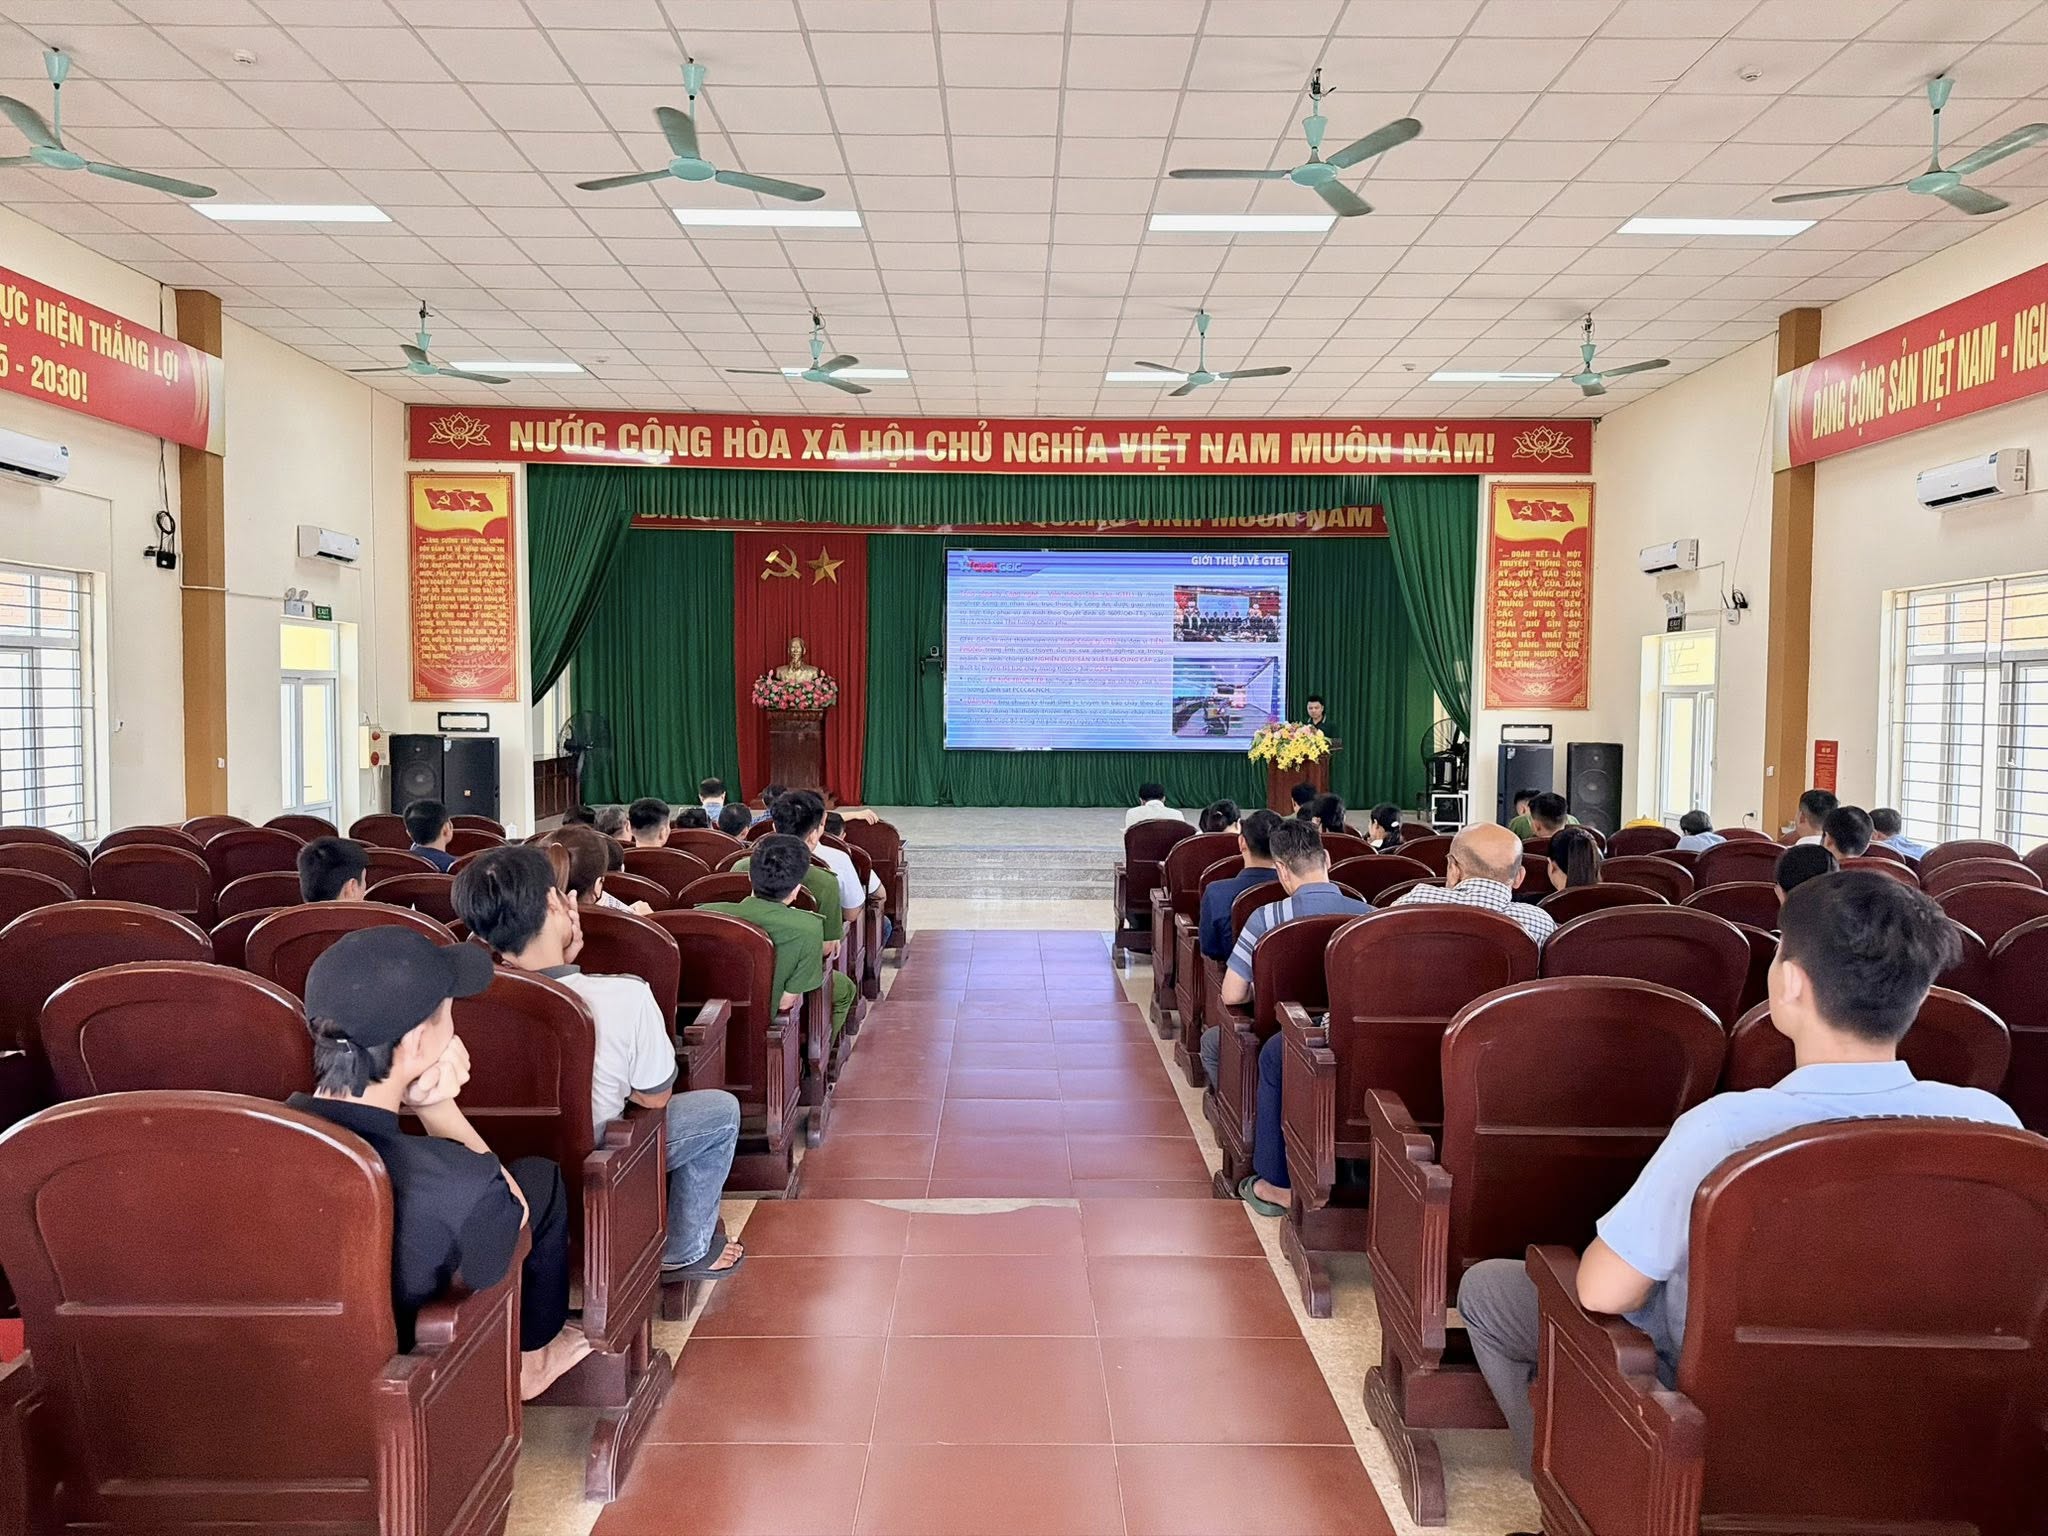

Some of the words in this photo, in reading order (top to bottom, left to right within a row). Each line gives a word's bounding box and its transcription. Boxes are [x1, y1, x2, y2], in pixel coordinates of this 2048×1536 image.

[35, 298, 84, 348] HIỆN
[89, 319, 149, 371] THẮNG
[154, 346, 179, 386] LỢI
[31, 354, 88, 403] 2030!
[1812, 369, 1846, 440] ĐẢNG
[1850, 360, 1885, 437] CỘNG
[1888, 337, 1919, 415] SẢN
[1922, 329, 1955, 413] VIỆT
[1957, 320, 1998, 392] NAM
[509, 413, 606, 454] NƯỚC
[618, 417, 712, 464] CỘNG
[723, 419, 792, 460] HÒA
[801, 422, 850, 460] XÃ
[859, 422, 915, 468] HỘI
[926, 420, 993, 463] CHỦ
[1003, 425, 1110, 464] NGHĨA
[1119, 425, 1192, 471] VIỆT
[1199, 433, 1280, 464] NAM
[1291, 425, 1392, 464] MUÔN
[1403, 425, 1496, 464] NĂM!
[1191, 554, 1213, 566] GIỚI
[1214, 555, 1245, 568] THIỆU
[1262, 556, 1286, 566] GTEL
